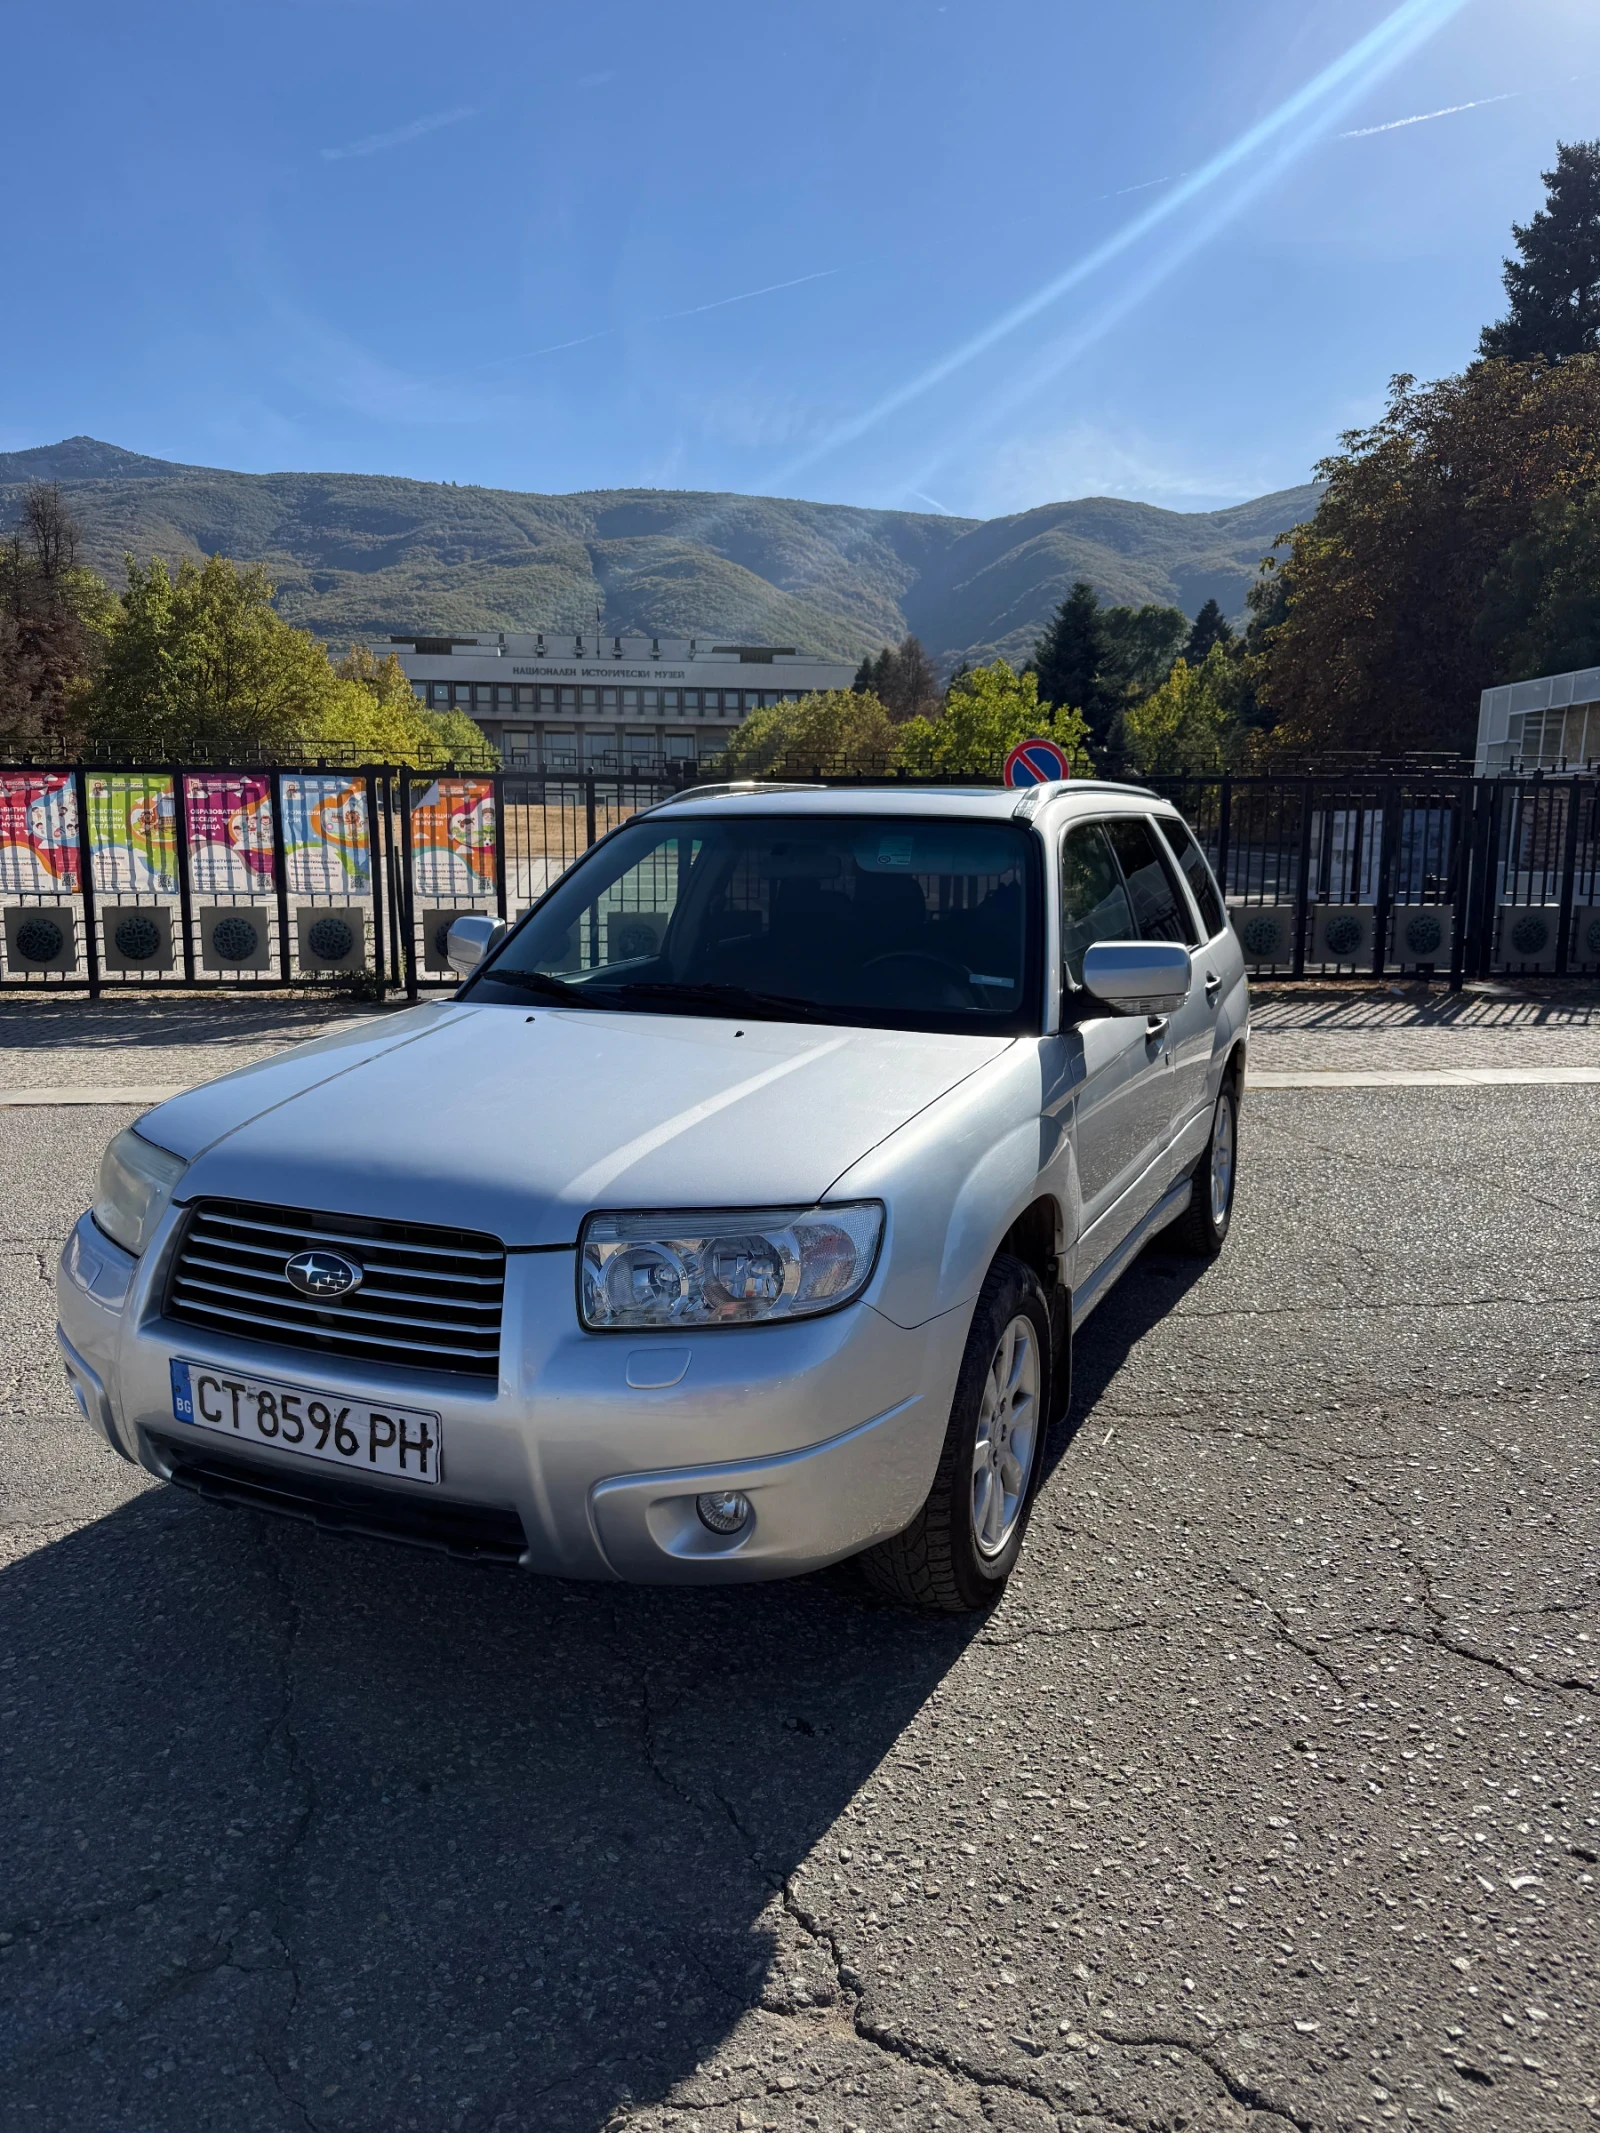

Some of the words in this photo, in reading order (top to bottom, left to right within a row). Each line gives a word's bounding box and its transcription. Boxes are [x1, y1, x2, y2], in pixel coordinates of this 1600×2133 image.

[512, 666, 577, 677] НАЦИОНАЛЕН
[581, 668, 650, 679] ИСТОРИЧЕСКИ
[654, 670, 685, 680] МУЗЕЙ
[176, 1397, 192, 1414] BG
[257, 1390, 360, 1457] 8596
